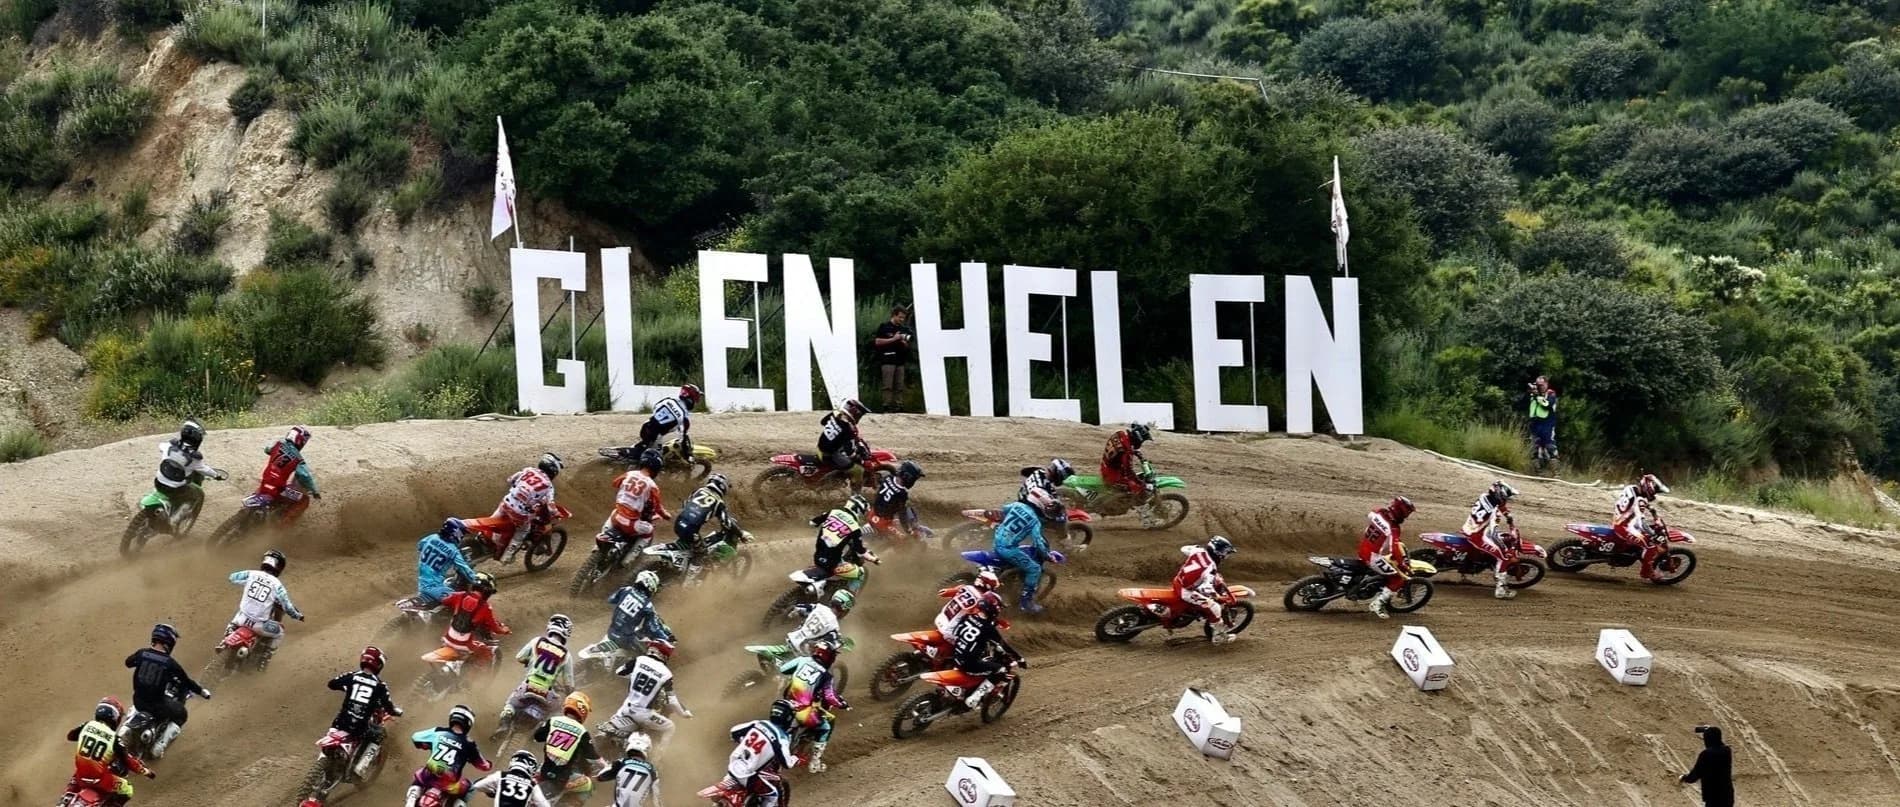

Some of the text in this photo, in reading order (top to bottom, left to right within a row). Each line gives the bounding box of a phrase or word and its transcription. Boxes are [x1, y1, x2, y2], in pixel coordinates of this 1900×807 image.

[510, 246, 1364, 435] GLEN HELEN
[625, 477, 646, 497] 53
[878, 482, 894, 502] 75
[691, 492, 715, 508] 79
[1003, 511, 1027, 535] 75
[421, 545, 446, 571] 972
[1598, 542, 1615, 552] 39
[1375, 558, 1394, 573] FLY
[247, 581, 271, 603] 316
[962, 621, 982, 643] 78
[350, 683, 373, 704] 12
[79, 735, 107, 762] 190
[744, 732, 766, 755] 34
[433, 744, 457, 766] 74
[502, 780, 528, 801] 33
[622, 768, 649, 792] 77
